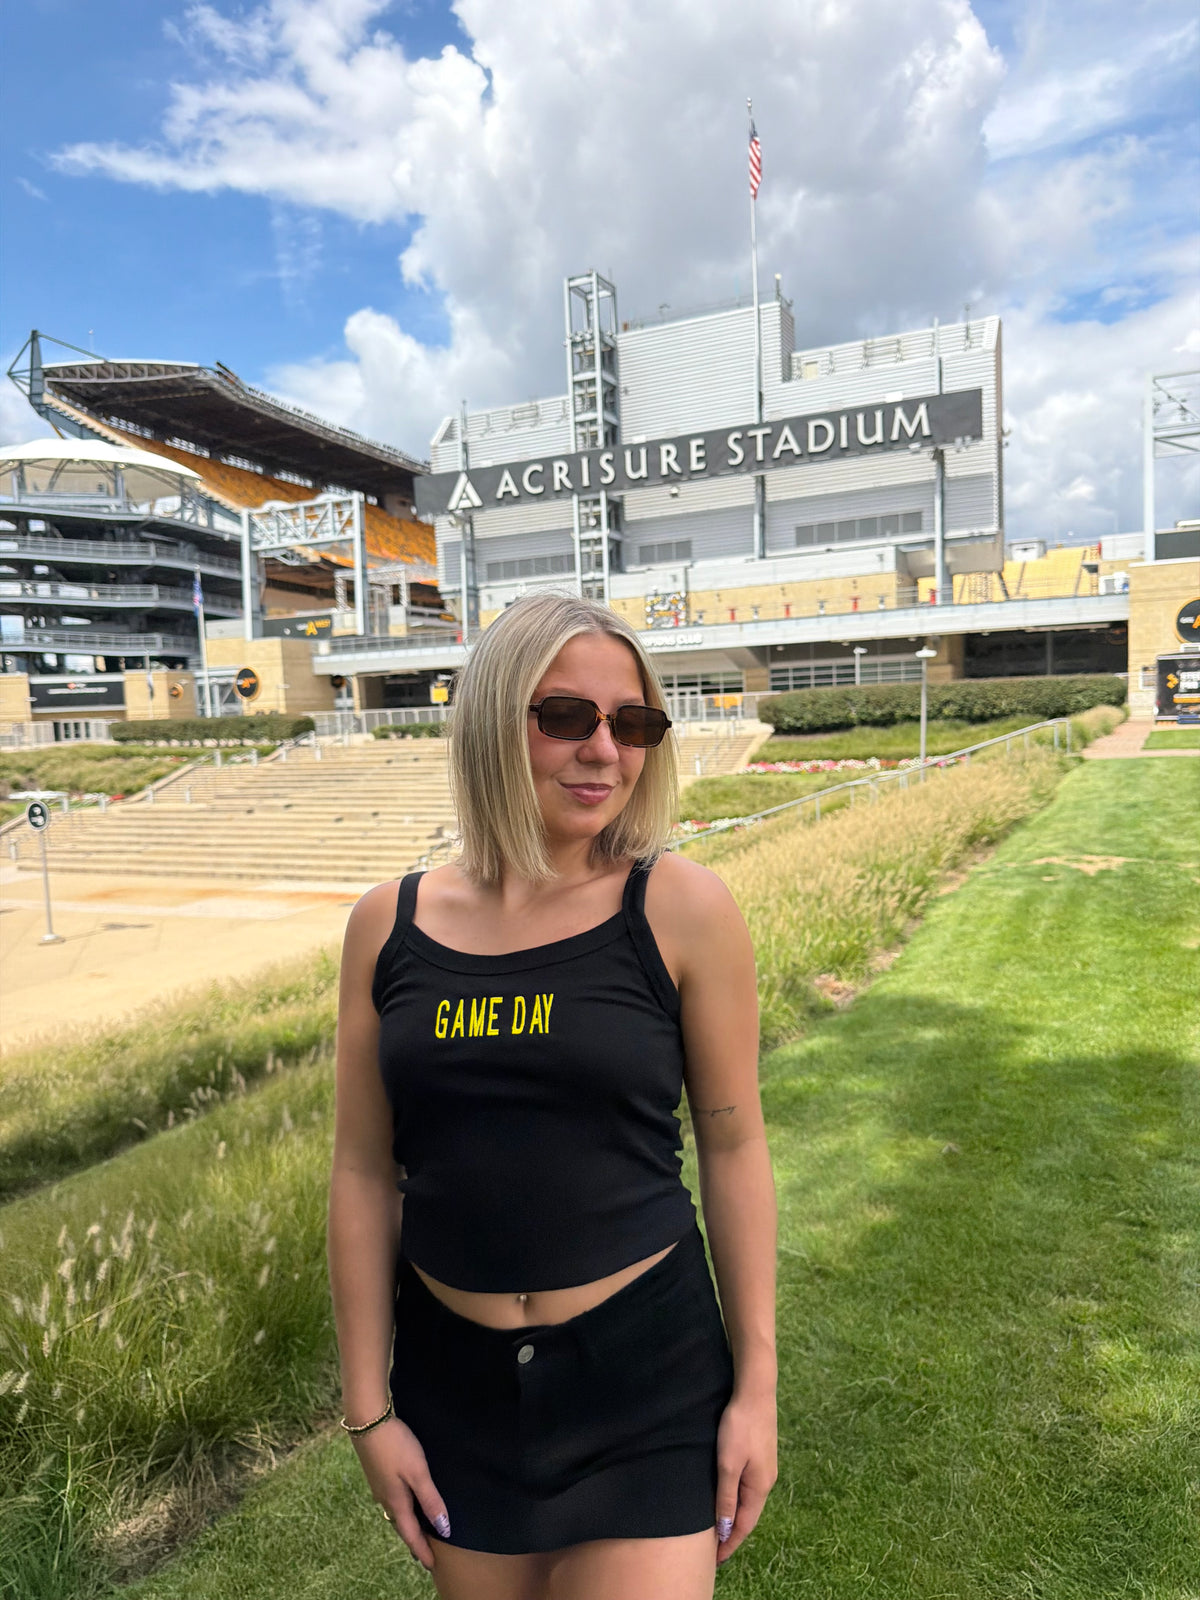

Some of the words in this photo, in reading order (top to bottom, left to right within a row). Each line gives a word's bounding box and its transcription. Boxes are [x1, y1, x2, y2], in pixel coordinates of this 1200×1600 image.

[496, 437, 707, 499] ACRISURE
[727, 401, 932, 467] STADIUM
[435, 997, 503, 1039] GAME
[511, 994, 554, 1035] DAY
